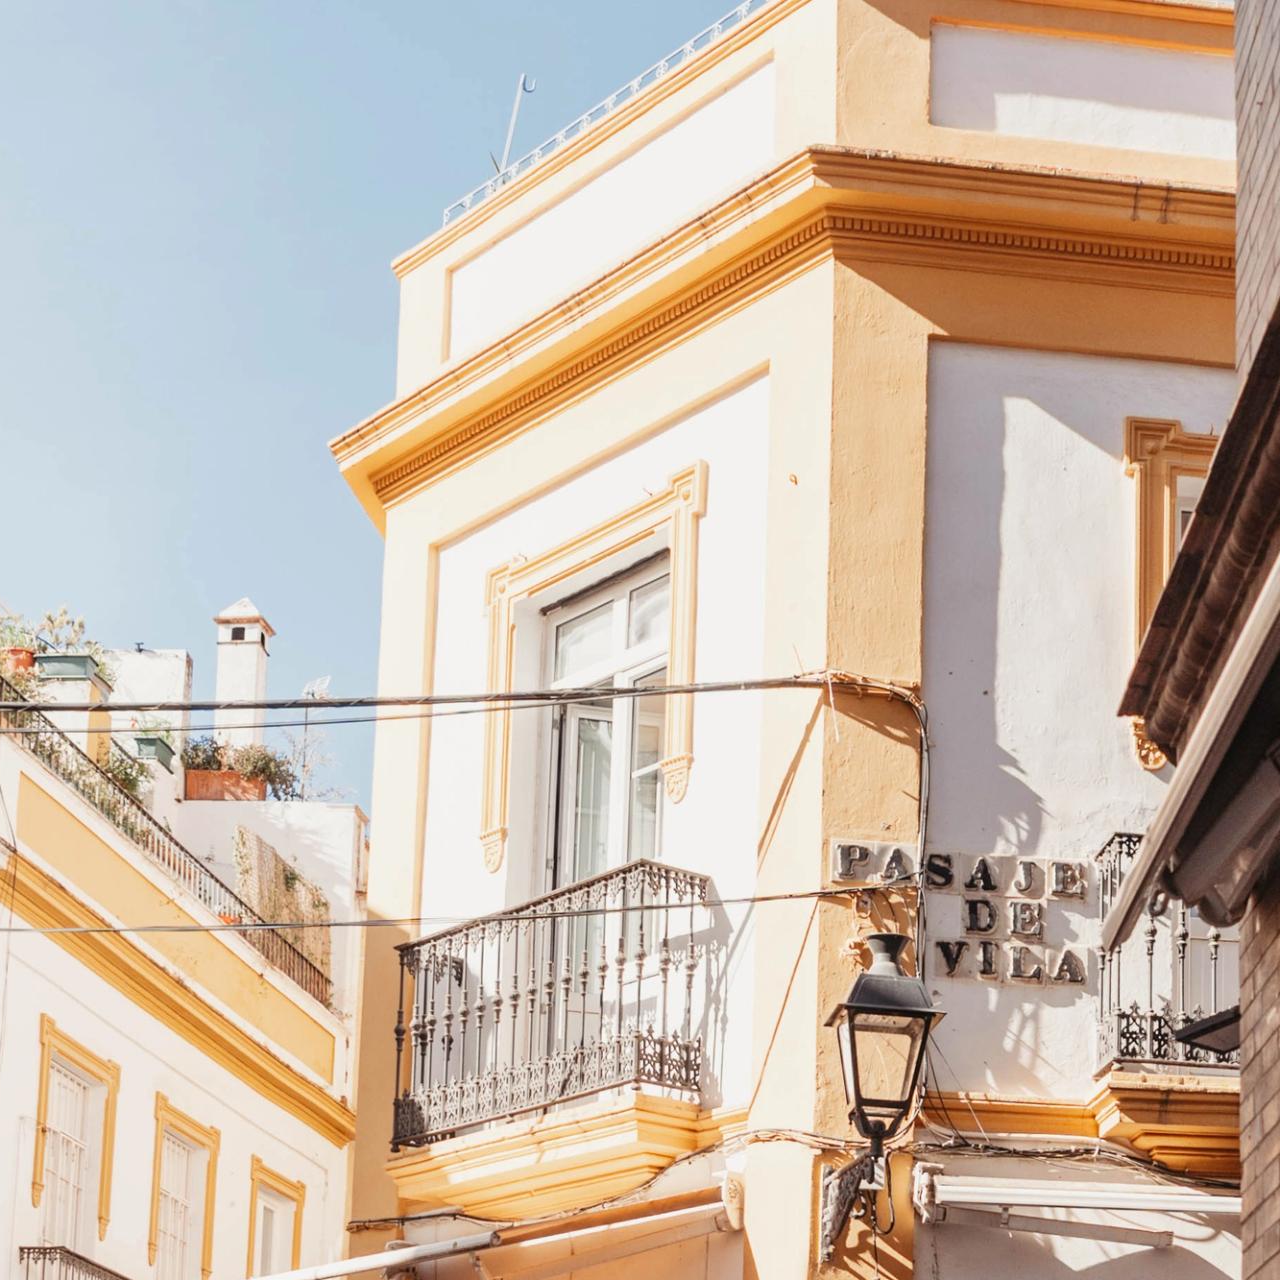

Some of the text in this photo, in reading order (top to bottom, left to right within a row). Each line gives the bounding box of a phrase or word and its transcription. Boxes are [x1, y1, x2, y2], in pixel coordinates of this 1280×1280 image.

[836, 843, 1086, 899] PASAJE
[964, 899, 1044, 937] DE
[935, 940, 1085, 985] VILA
